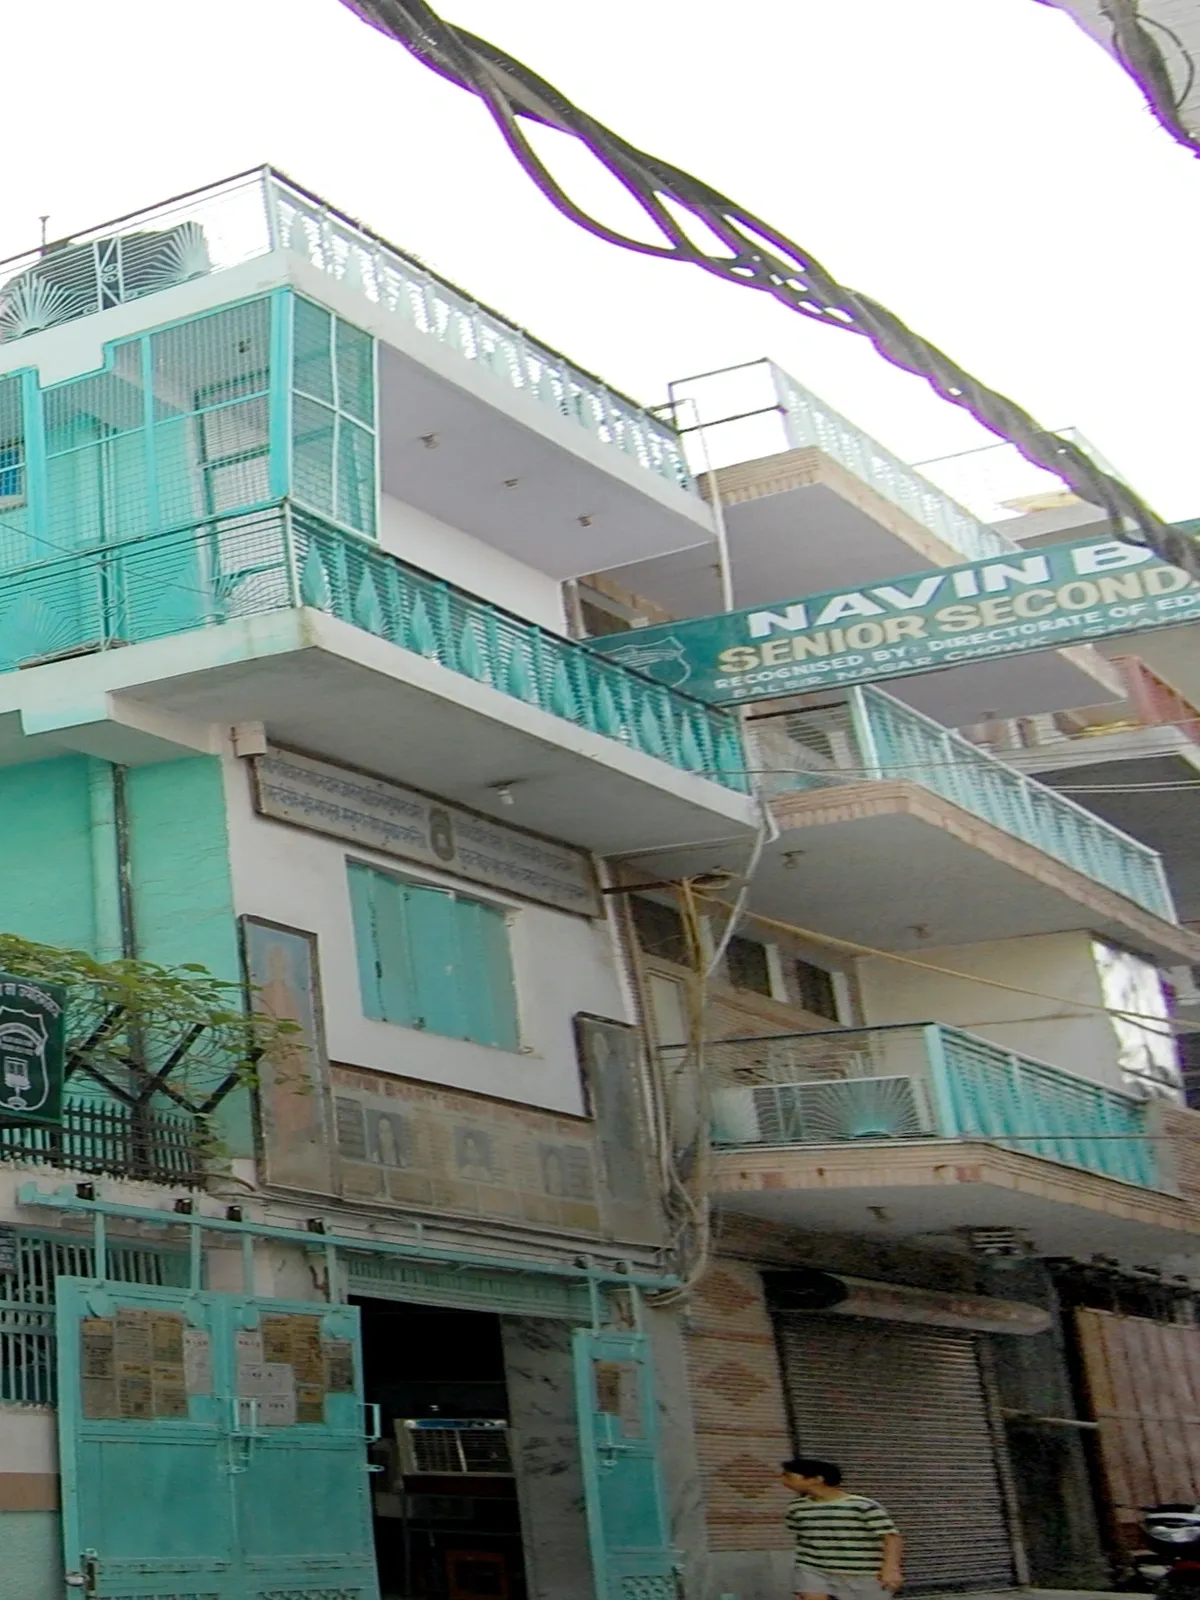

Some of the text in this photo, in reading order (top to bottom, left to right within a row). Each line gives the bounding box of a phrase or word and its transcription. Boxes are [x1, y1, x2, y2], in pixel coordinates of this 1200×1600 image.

[718, 565, 1200, 673] SENIOR SECOND
[747, 541, 1153, 638] NAVIN B
[714, 654, 865, 689] RECOGNISED
[926, 611, 1102, 652] DIRECTORATE
[1108, 602, 1149, 618] OF
[836, 655, 933, 681] NAGAR
[944, 636, 1051, 661] CHOWK
